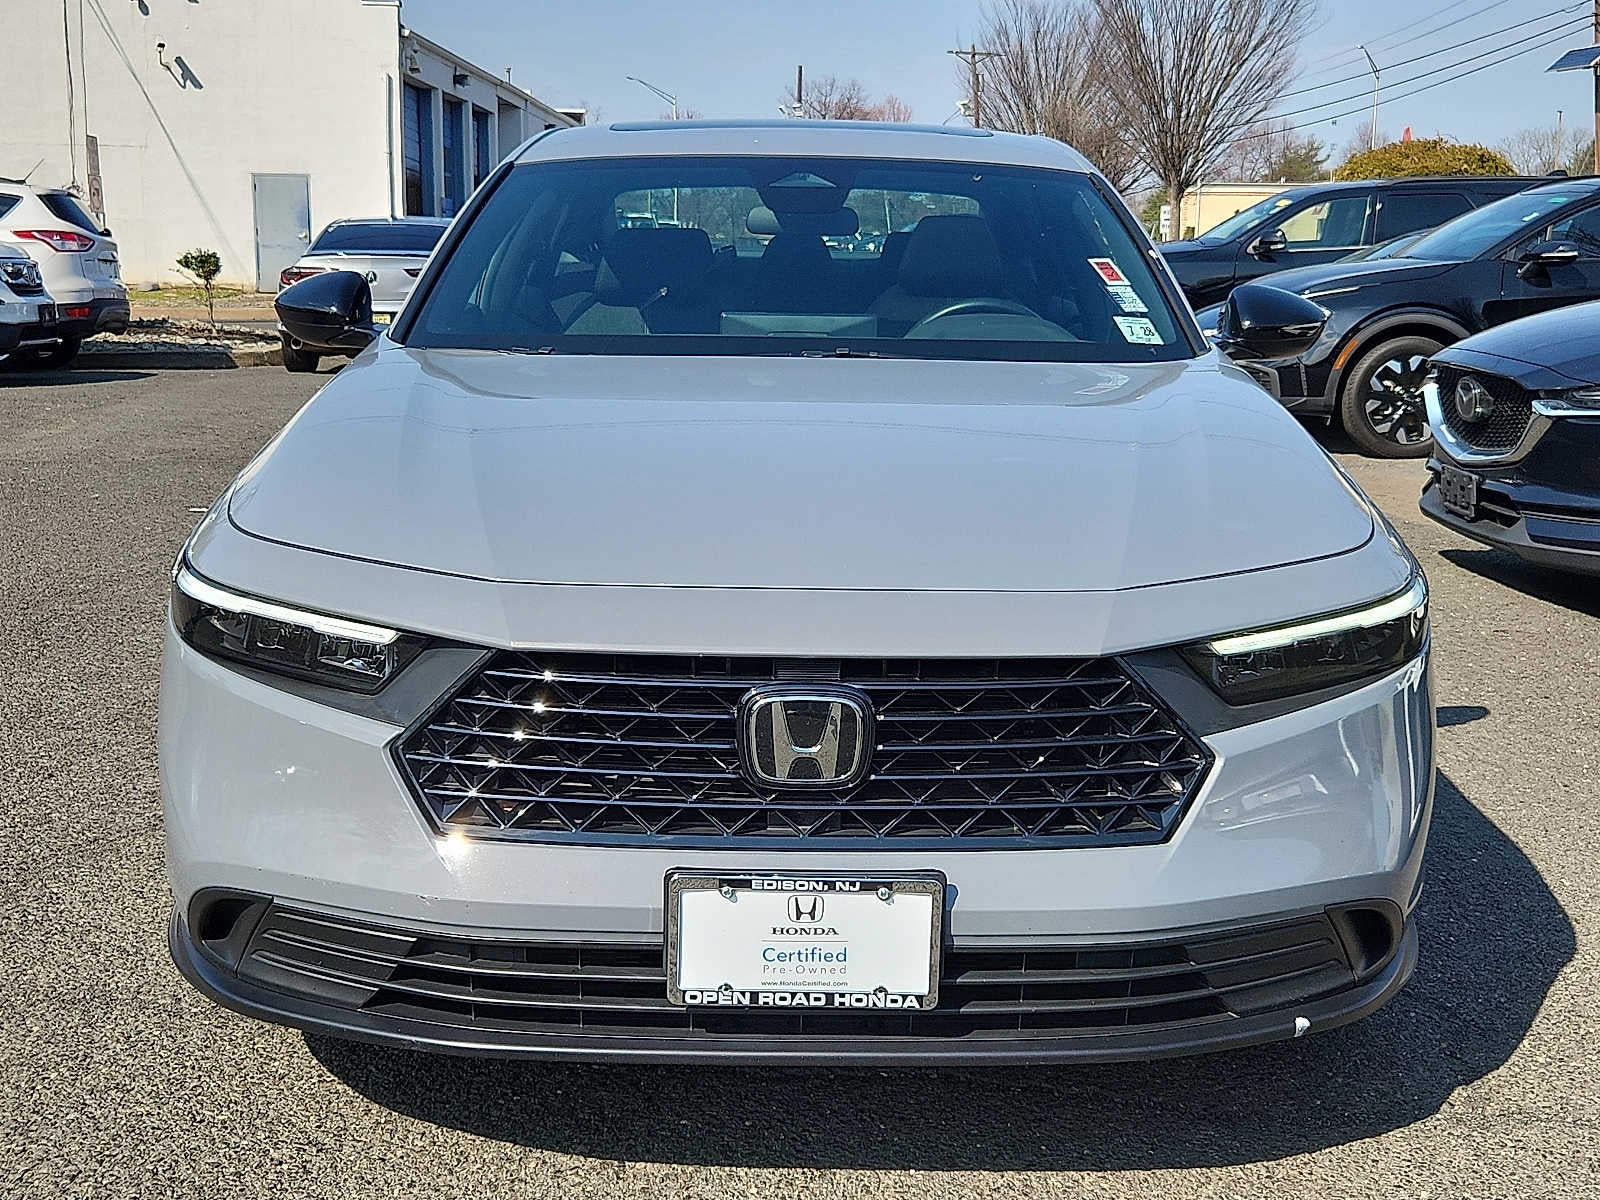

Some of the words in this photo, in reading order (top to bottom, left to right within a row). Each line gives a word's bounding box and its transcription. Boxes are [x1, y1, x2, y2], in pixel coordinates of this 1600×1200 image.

[751, 880, 829, 891] EDISON,
[835, 881, 861, 893] NJ
[770, 926, 839, 936] HONDA
[762, 946, 847, 963] Certified
[762, 964, 847, 975] Pre-Owned
[761, 980, 849, 988] www.HondaCertified.com
[684, 990, 751, 1006] OPEN
[758, 991, 826, 1007] ROAD
[833, 992, 921, 1009] HONDA
